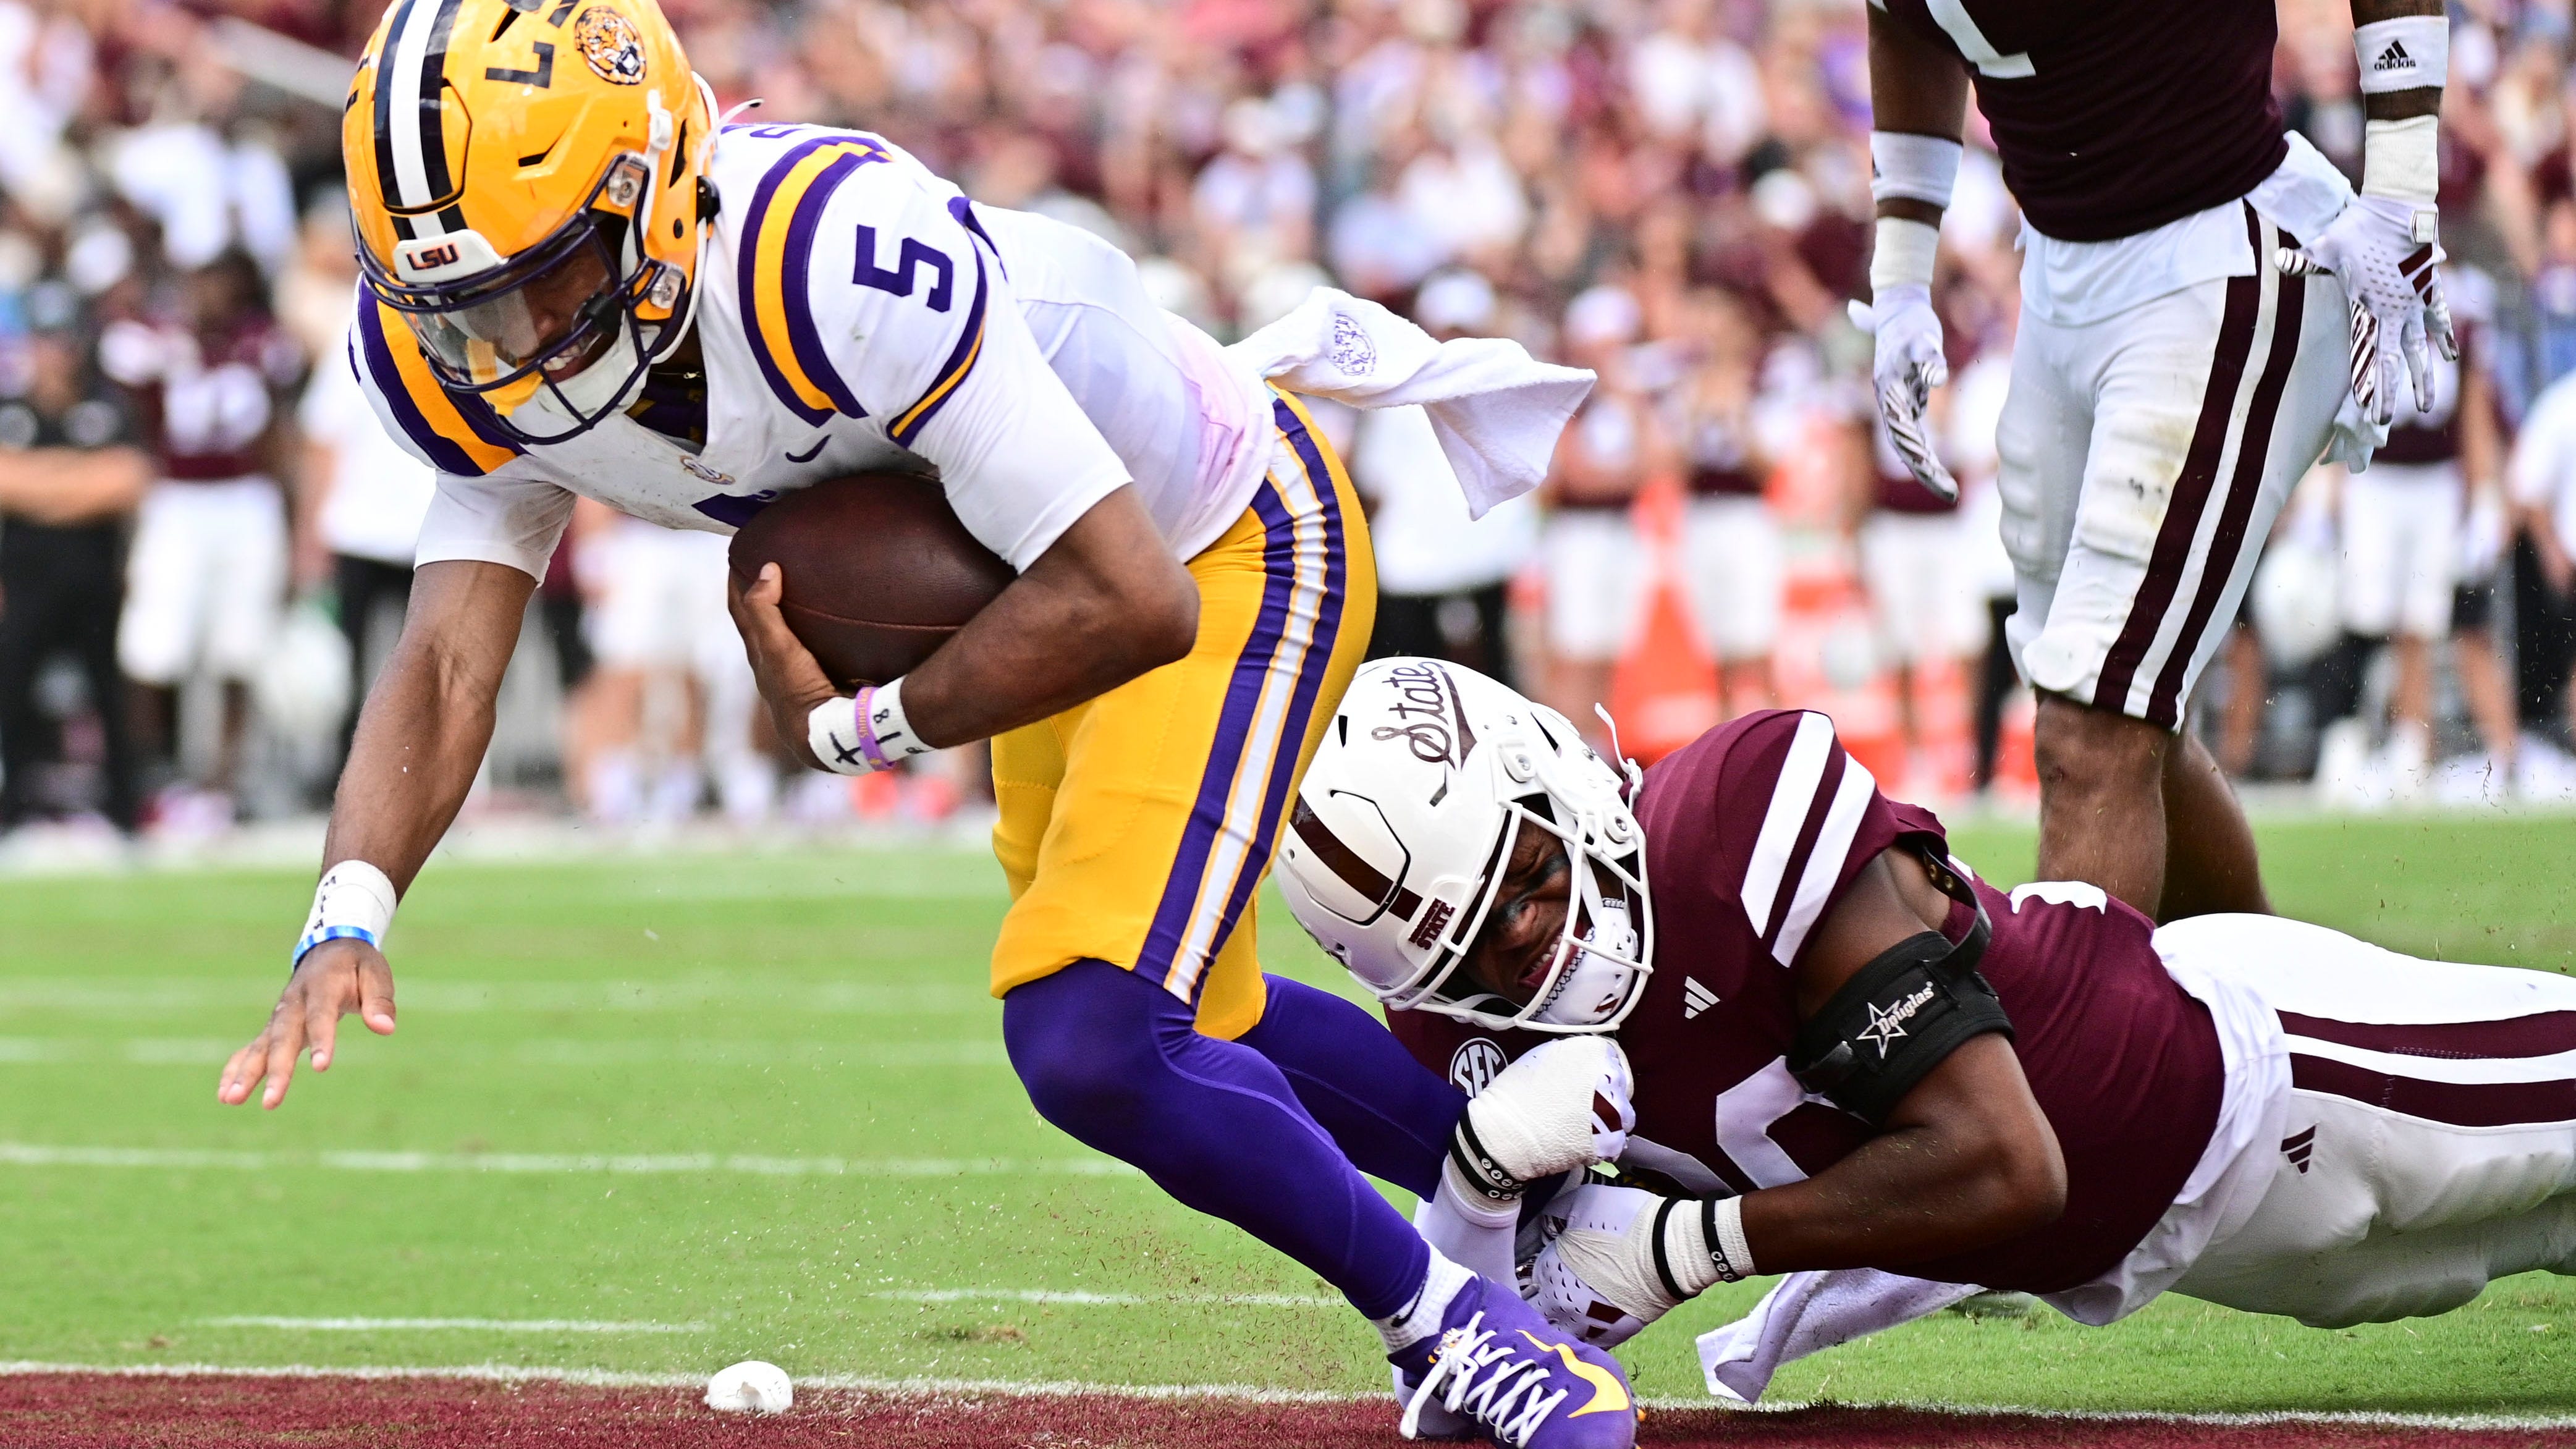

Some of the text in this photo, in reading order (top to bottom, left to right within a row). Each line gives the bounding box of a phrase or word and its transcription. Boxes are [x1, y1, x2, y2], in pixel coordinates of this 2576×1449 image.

[2374, 57, 2416, 71] adidas
[406, 243, 460, 271] LSU
[853, 224, 953, 313] 5
[1371, 661, 1459, 771] State
[1416, 901, 1456, 950] STATE
[1877, 986, 1935, 1036] Douglas
